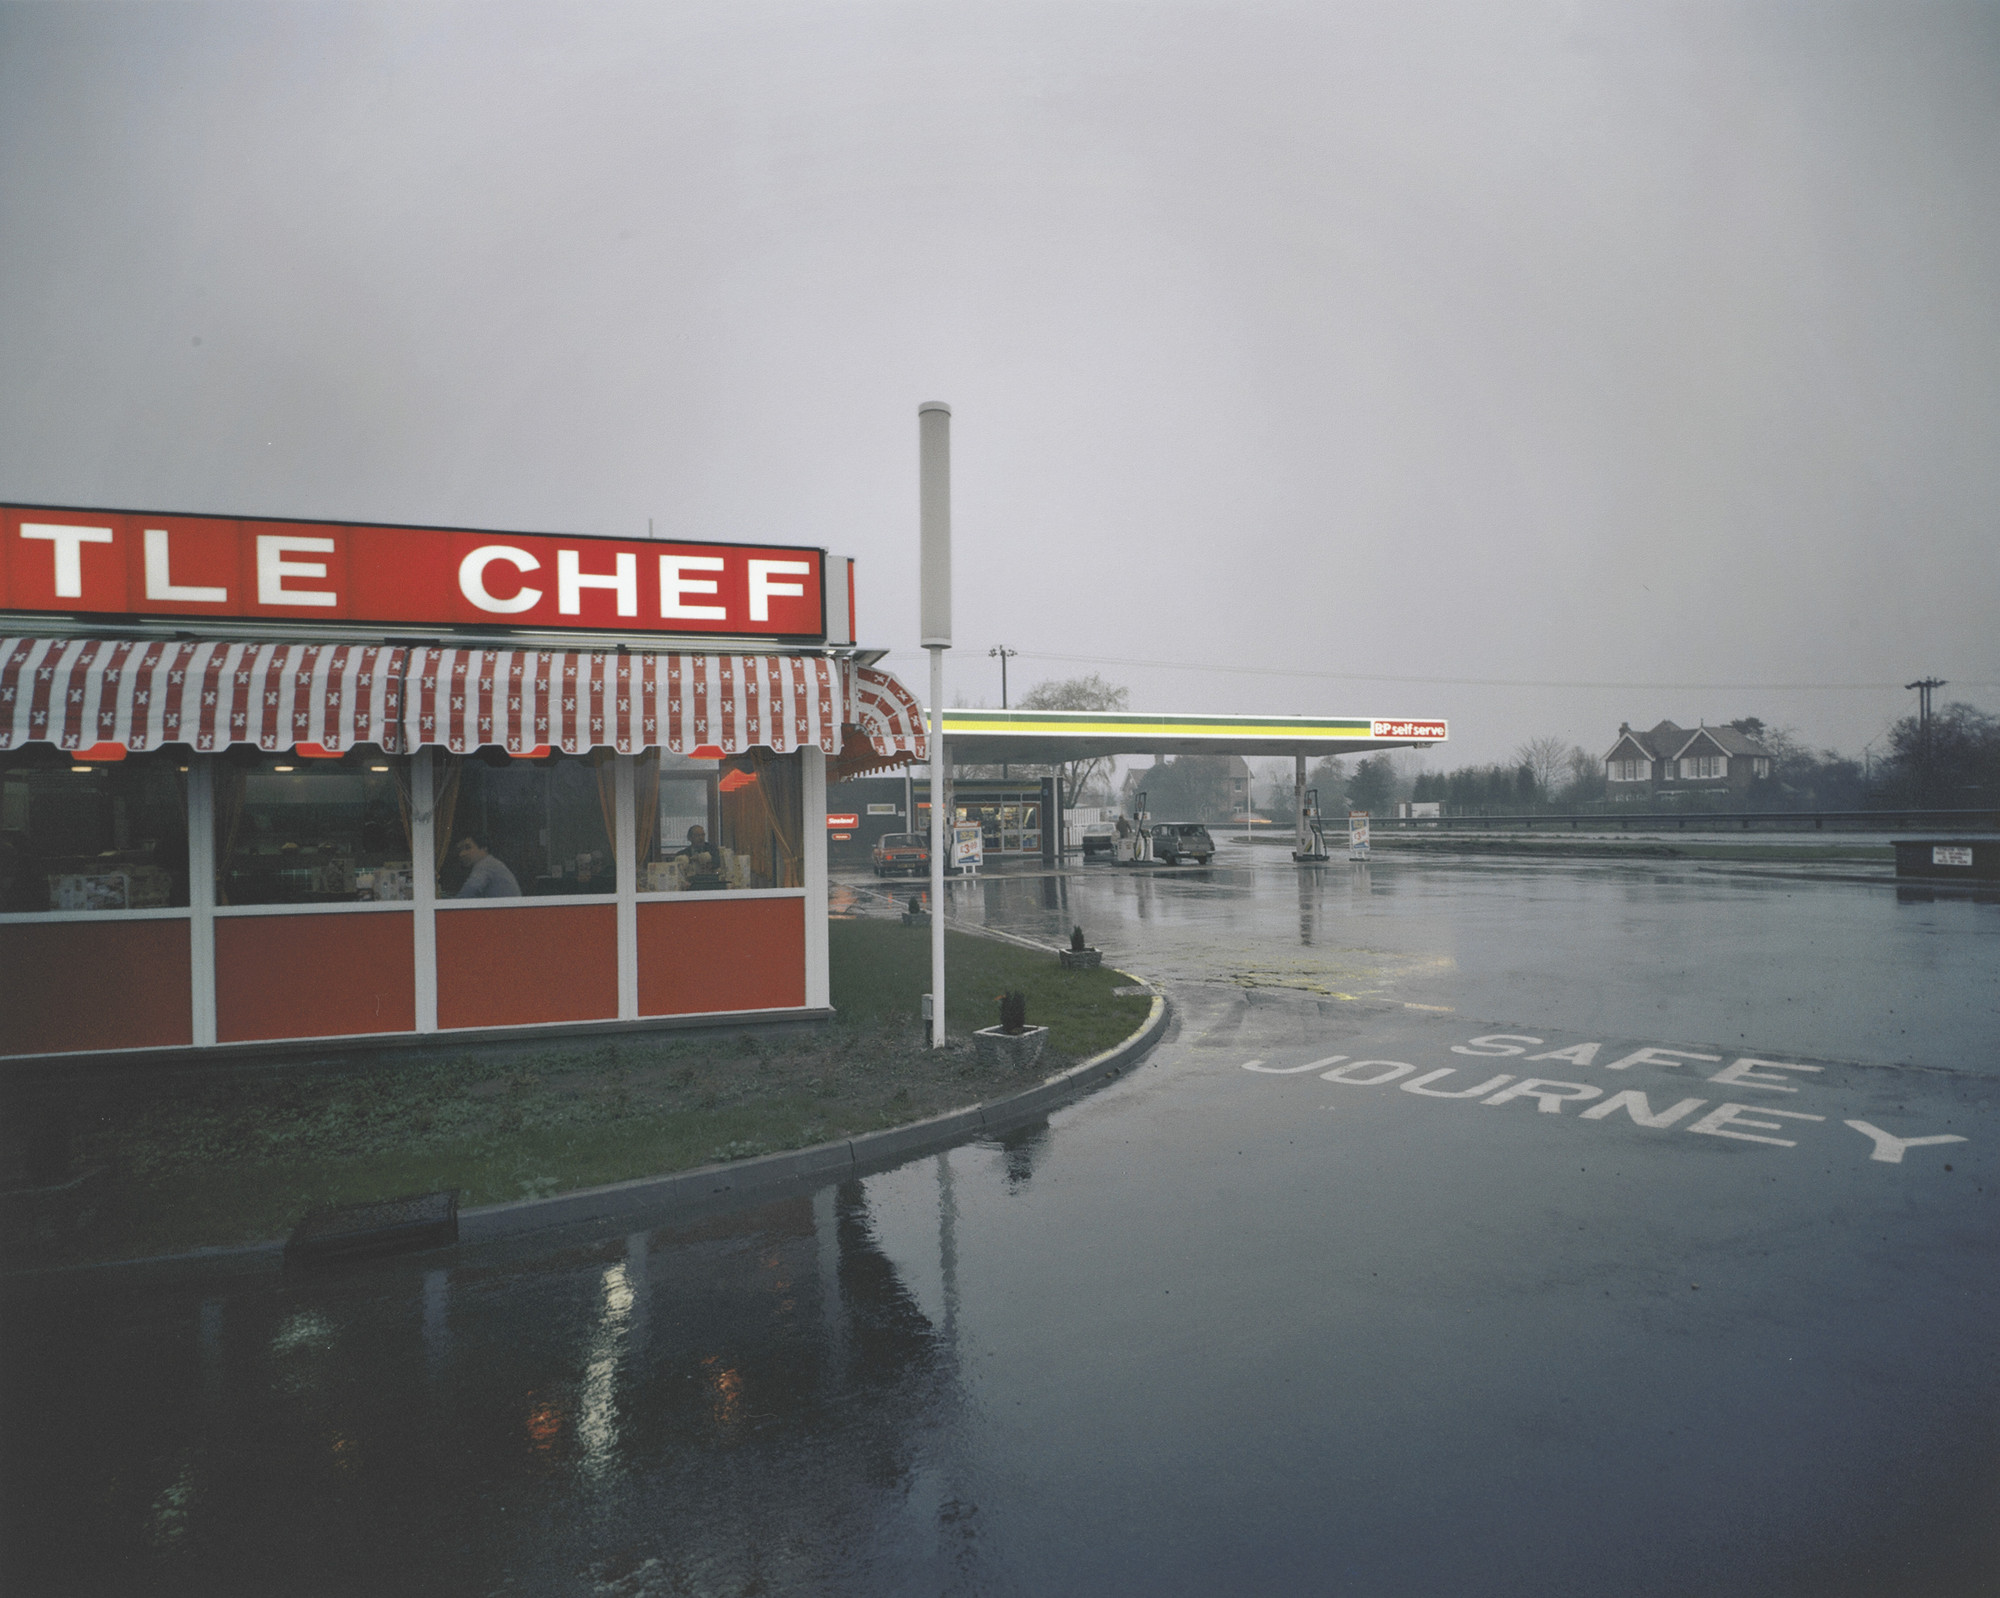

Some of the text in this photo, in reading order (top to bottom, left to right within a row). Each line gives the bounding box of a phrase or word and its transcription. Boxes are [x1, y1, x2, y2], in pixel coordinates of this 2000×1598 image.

[458, 545, 810, 622] CHEF
[1375, 722, 1444, 736] BP self serve
[1451, 1034, 1825, 1093] SAFE
[1241, 1055, 1969, 1164] JOURNEY
